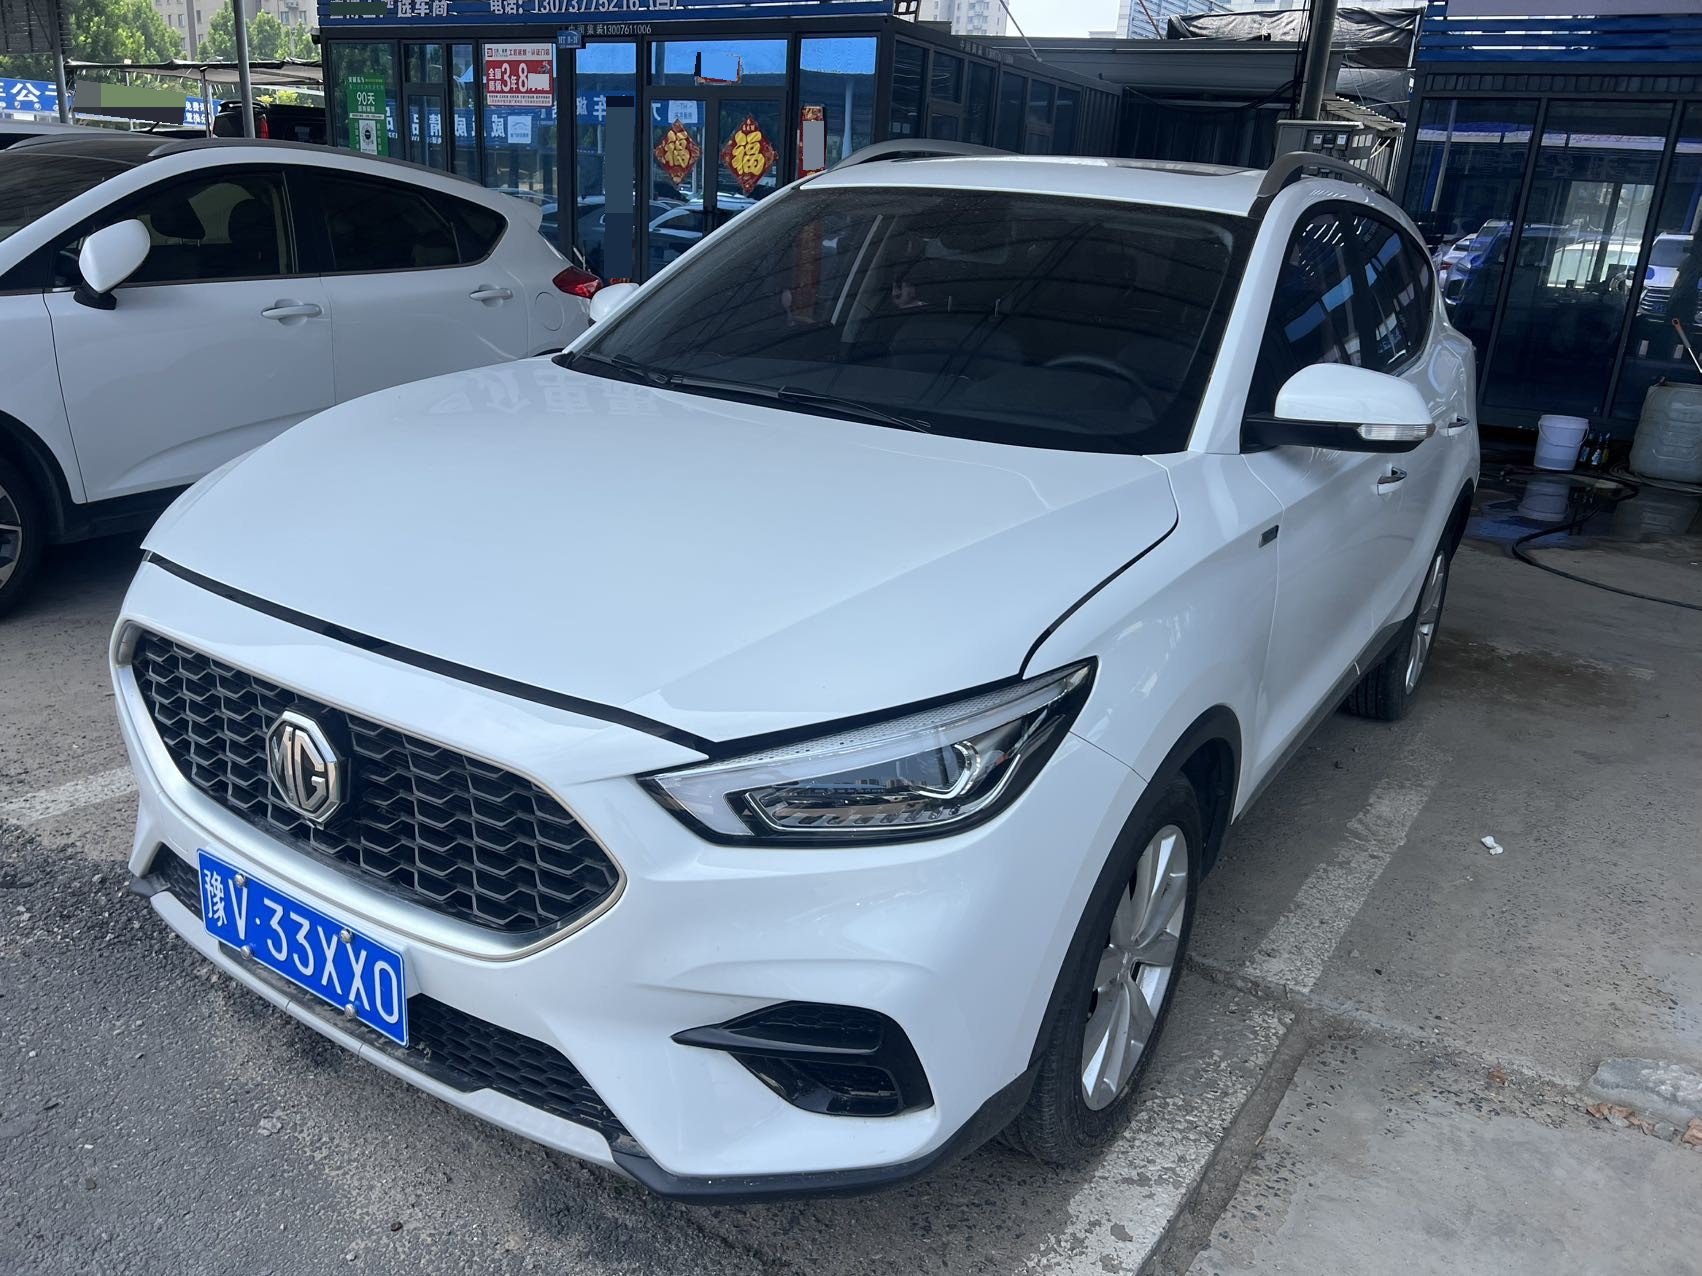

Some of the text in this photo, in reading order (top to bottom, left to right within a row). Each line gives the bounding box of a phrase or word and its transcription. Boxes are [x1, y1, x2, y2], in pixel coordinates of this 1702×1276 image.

[356, 91, 376, 105] 90天
[664, 130, 690, 168] 福
[731, 130, 765, 175] 福
[270, 725, 327, 814] MG
